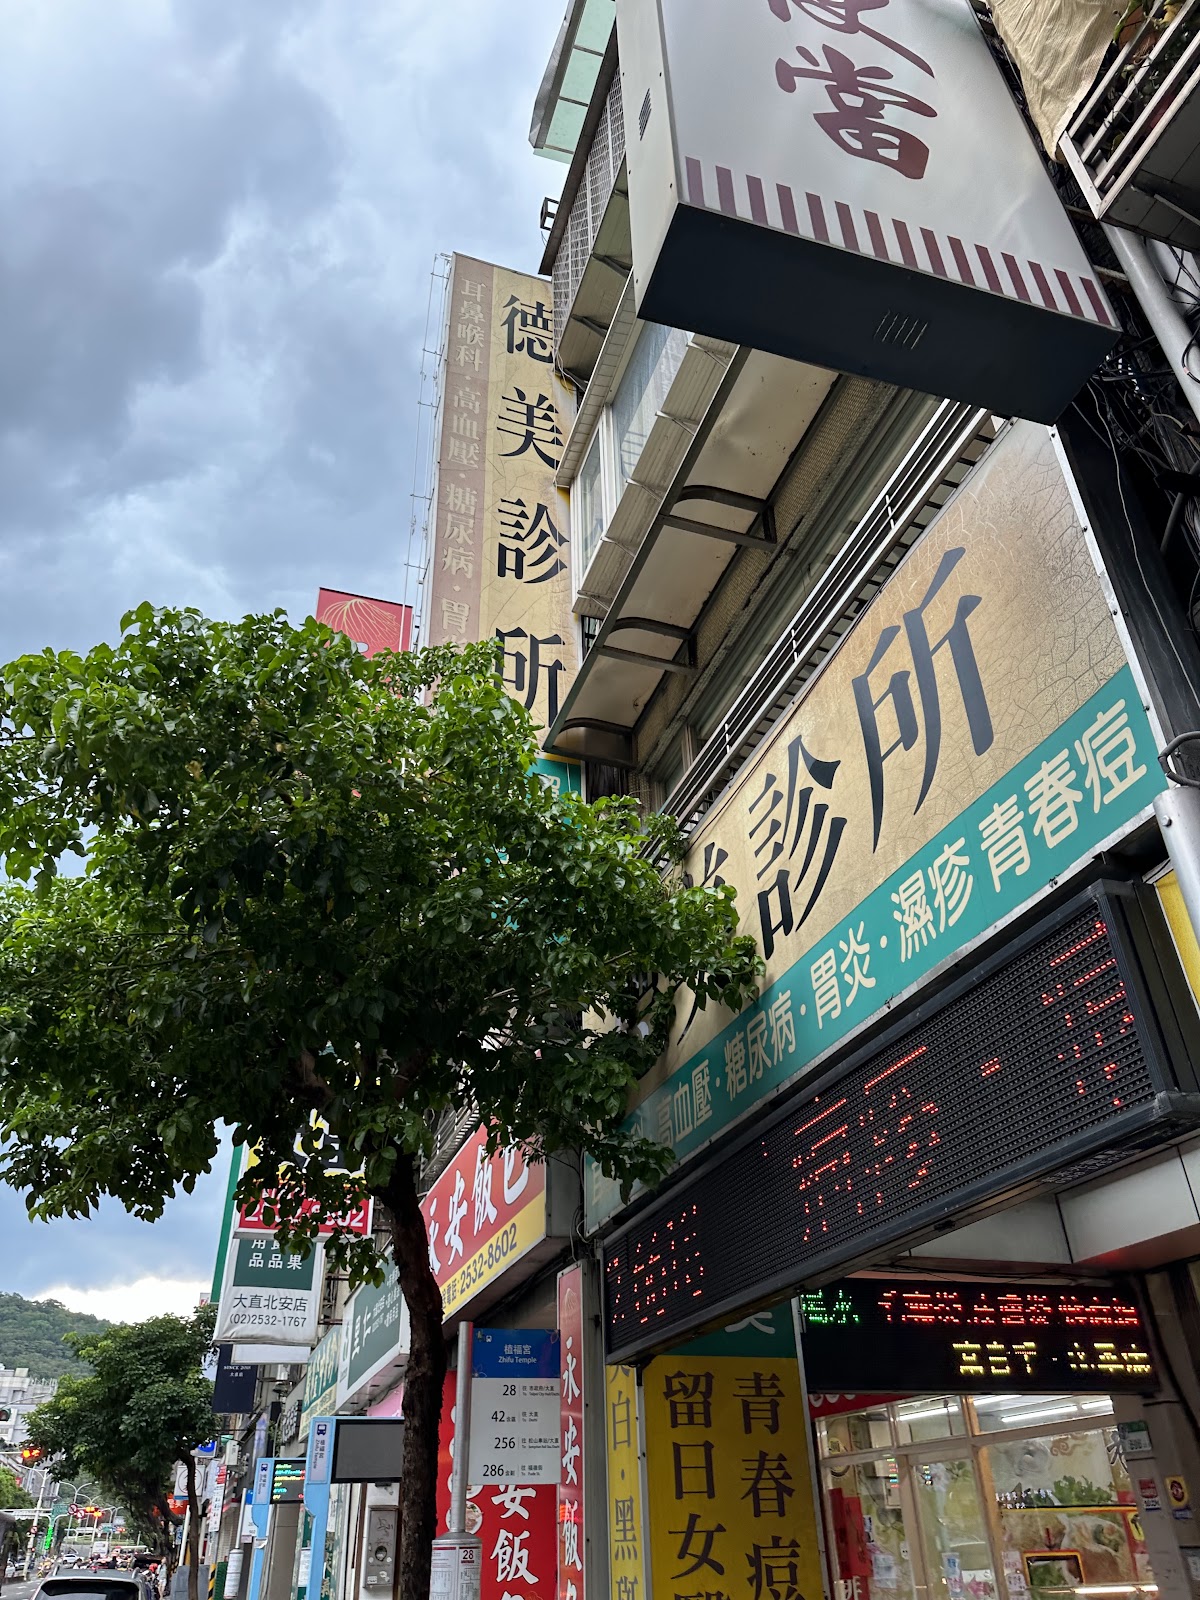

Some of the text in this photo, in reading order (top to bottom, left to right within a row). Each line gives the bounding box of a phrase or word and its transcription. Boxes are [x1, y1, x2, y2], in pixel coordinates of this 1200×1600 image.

[440, 277, 488, 651] 耳鼻喉科·高血壓·糖尿病·胃
[494, 294, 569, 728] 德美診所
[232, 1293, 308, 1312] 大直北安店
[229, 1314, 307, 1327] (02)2532-1767
[503, 1344, 532, 1355] 植福宮
[515, 1356, 538, 1364] Temple
[502, 1384, 517, 1396] 28
[491, 1411, 505, 1422] 42
[494, 1437, 515, 1449] 256
[482, 1464, 504, 1477] 286
[732, 1372, 805, 1600] 青春痘
[490, 1485, 540, 1600] 安飯
[462, 1549, 474, 1560] 28
